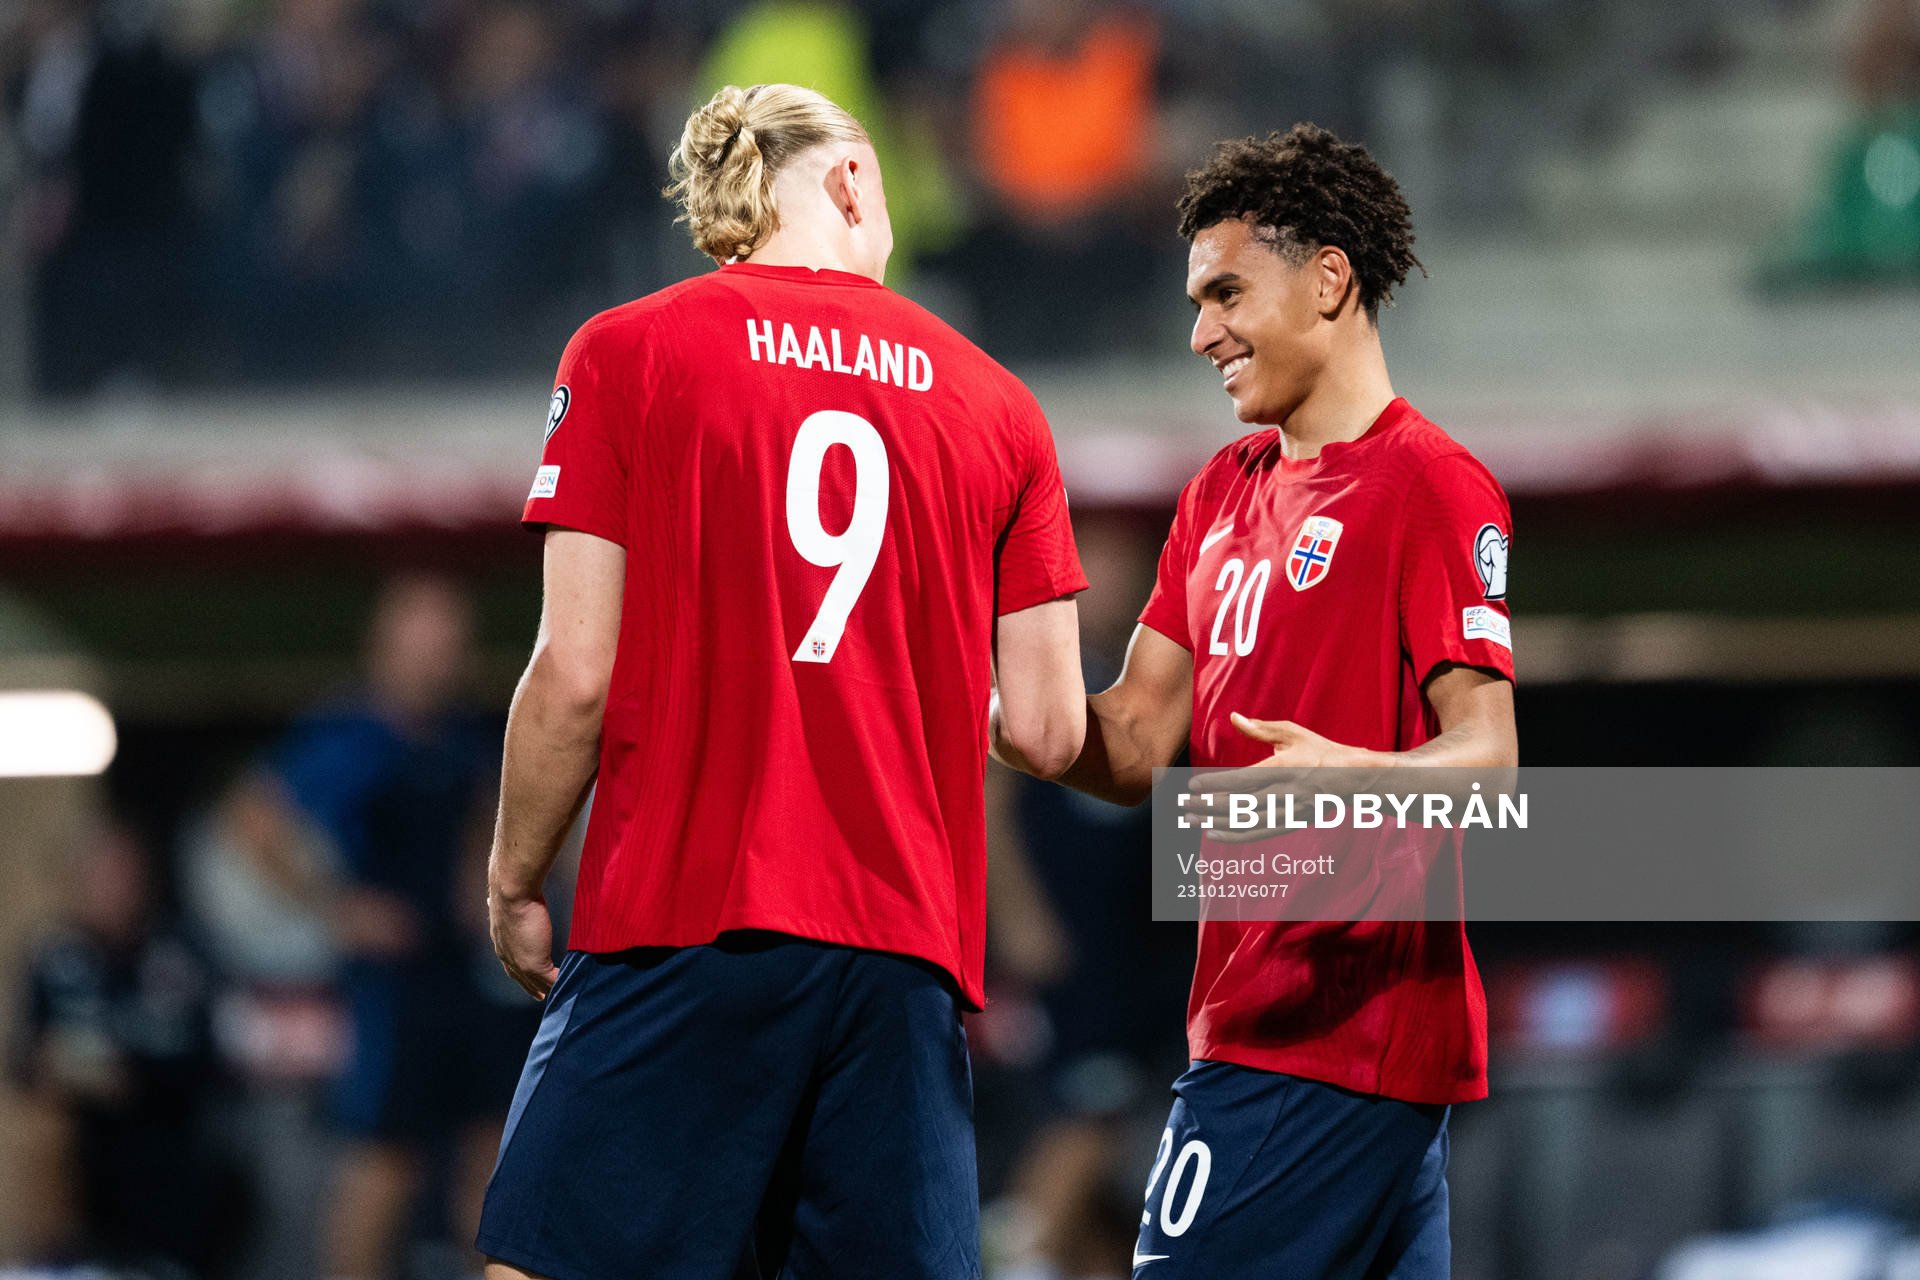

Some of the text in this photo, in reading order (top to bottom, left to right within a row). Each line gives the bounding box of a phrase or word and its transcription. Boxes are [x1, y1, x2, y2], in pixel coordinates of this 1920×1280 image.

[746, 319, 933, 392] HAALAND
[786, 410, 890, 664] 9
[1209, 558, 1271, 657] 20
